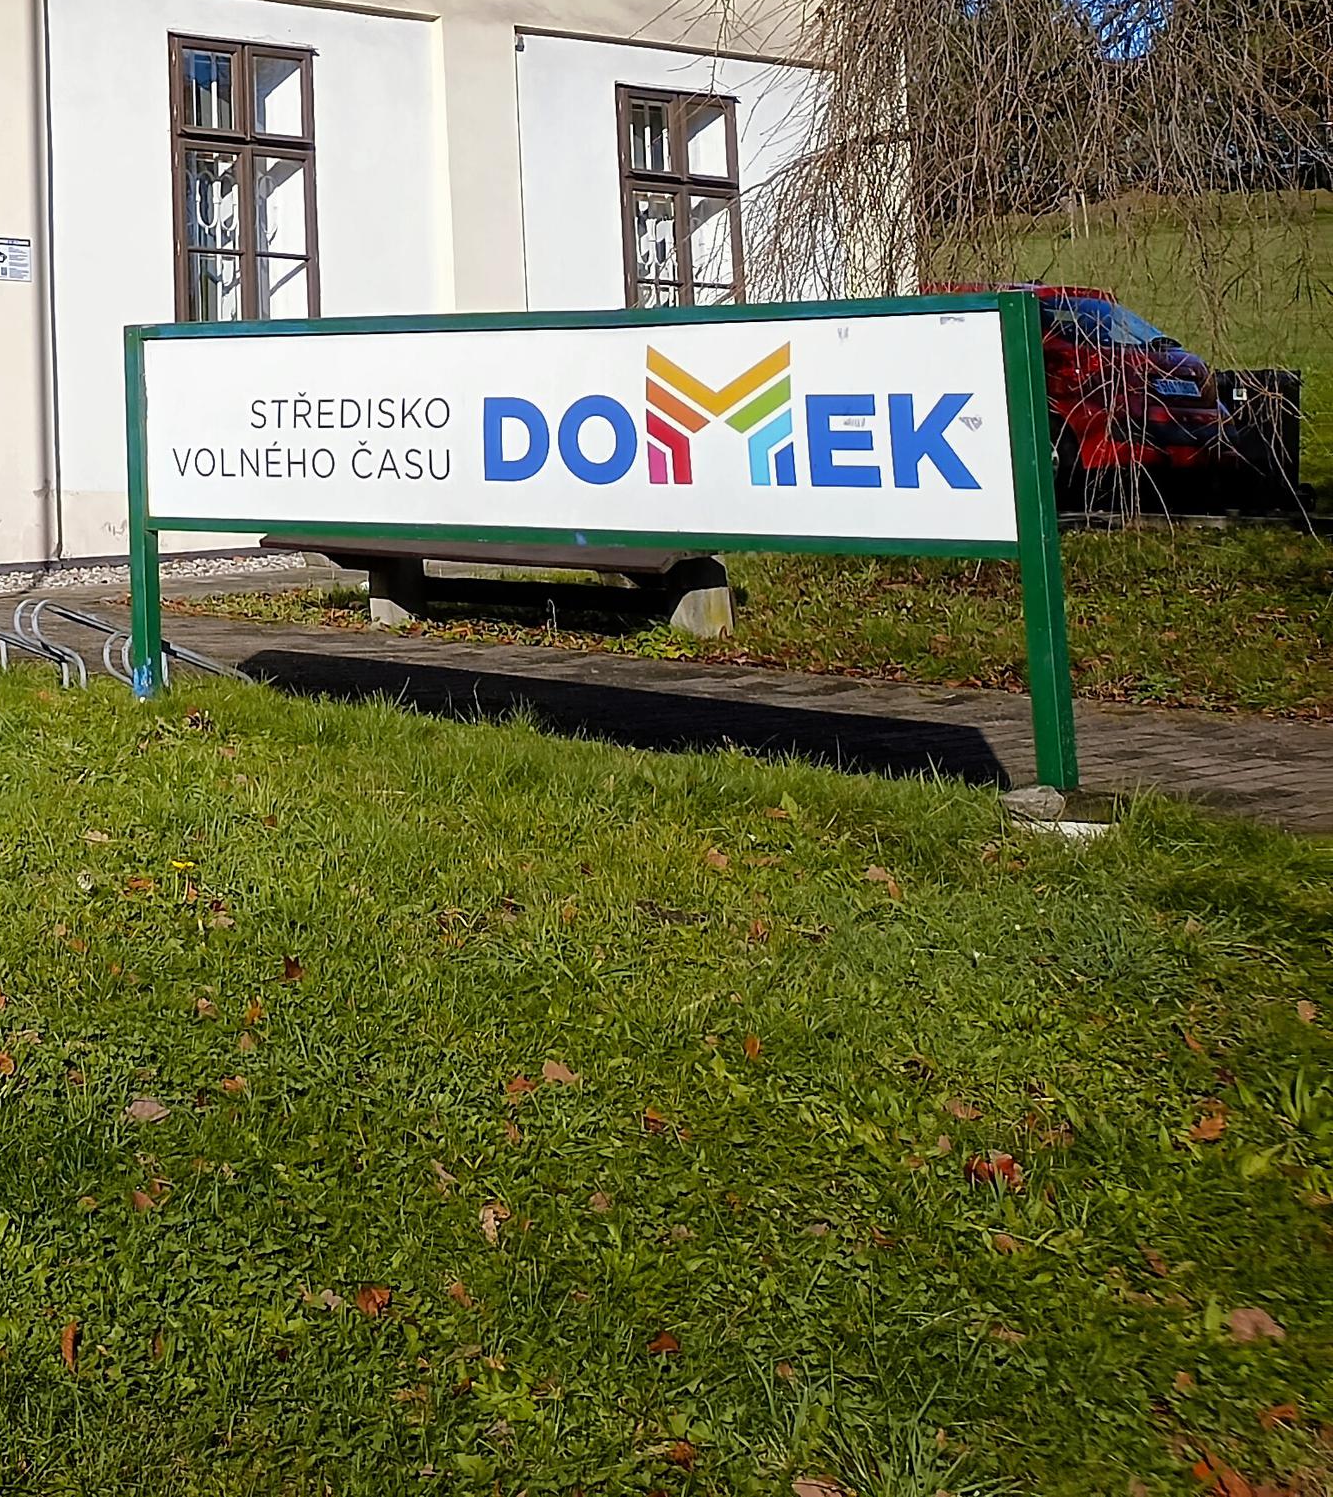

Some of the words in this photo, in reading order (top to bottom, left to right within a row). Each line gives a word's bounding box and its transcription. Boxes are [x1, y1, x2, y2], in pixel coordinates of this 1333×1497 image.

[250, 392, 450, 428] STŘEDISKO
[484, 341, 982, 490] DOMEK
[172, 441, 335, 478] VOLNÉHO
[351, 440, 450, 480] ČASU
